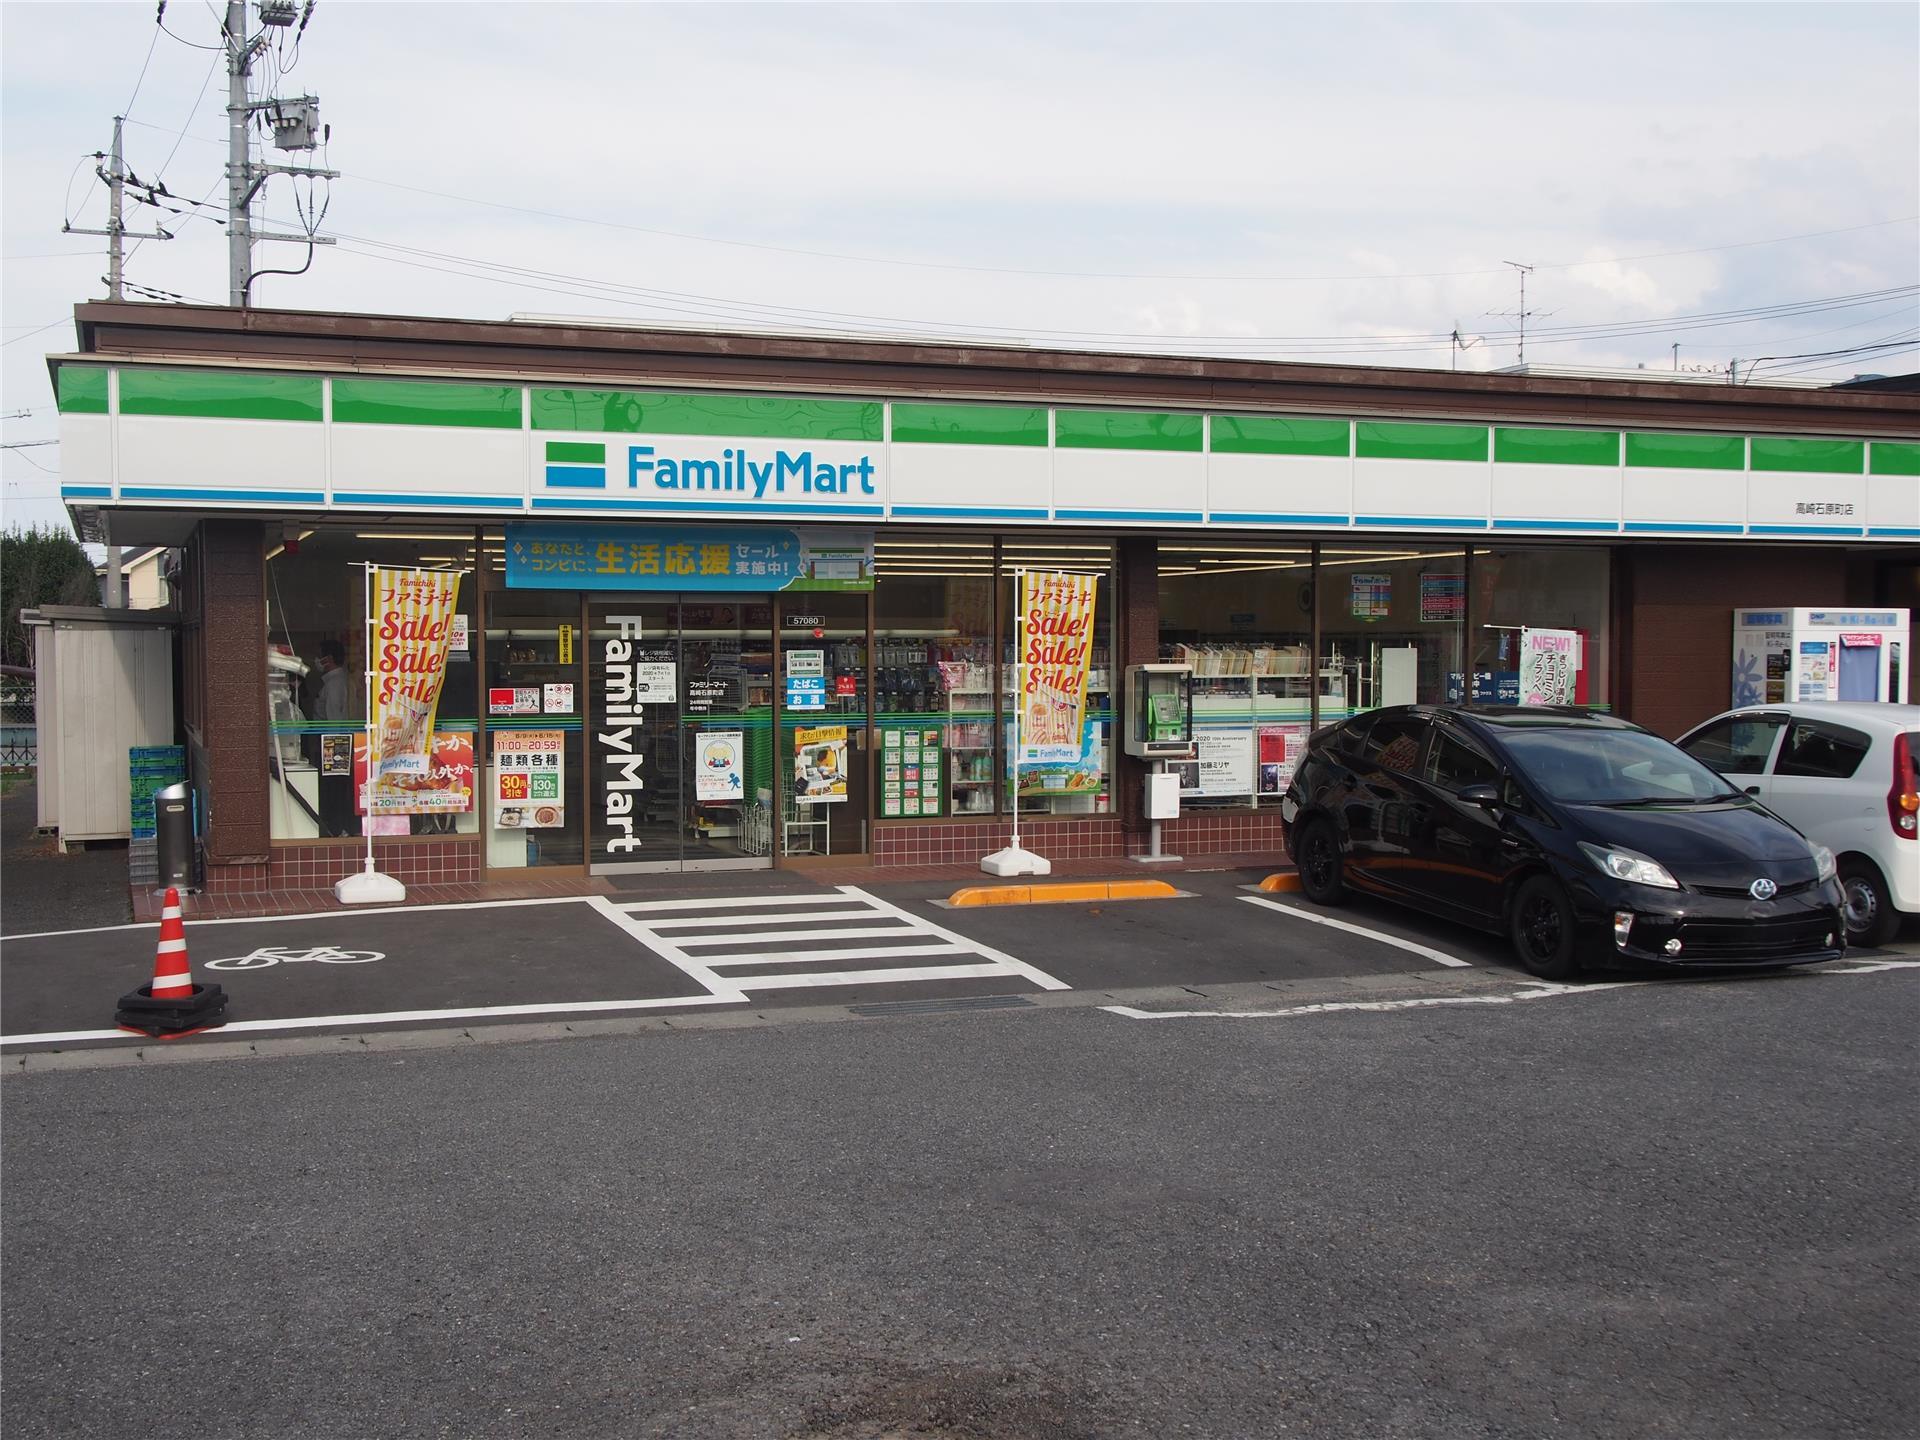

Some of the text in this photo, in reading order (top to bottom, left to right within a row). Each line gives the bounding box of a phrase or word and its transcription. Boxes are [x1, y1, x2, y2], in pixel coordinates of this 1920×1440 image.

[628, 445, 874, 498] FamilyMart
[1796, 502, 1854, 515] 高崎石原町店
[531, 543, 591, 555] あなたと、
[735, 544, 779, 558] セール
[531, 558, 593, 573] コンビに、
[596, 543, 730, 575] 生活応援
[400, 578, 436, 588] Famichiki
[1044, 579, 1076, 588] Famichiki
[381, 589, 453, 607] ファミチキ
[1027, 589, 1091, 606] ファミチキ
[379, 611, 450, 640] Sale!
[1026, 609, 1090, 637] Sale!
[1532, 635, 1571, 651] NEW!
[379, 644, 448, 673] Sale!
[1026, 638, 1087, 666] Sale!
[1026, 667, 1084, 694] Sale!
[1532, 653, 1544, 692] フラッペ
[1543, 654, 1556, 704] チョコミン
[793, 679, 819, 689] たばこ
[598, 615, 644, 853] FamilyMart
[500, 754, 558, 767] 麺類各種
[1200, 761, 1230, 769] 加藤ミリヤ
[501, 775, 527, 789] 30円
[505, 789, 522, 798] 引き
